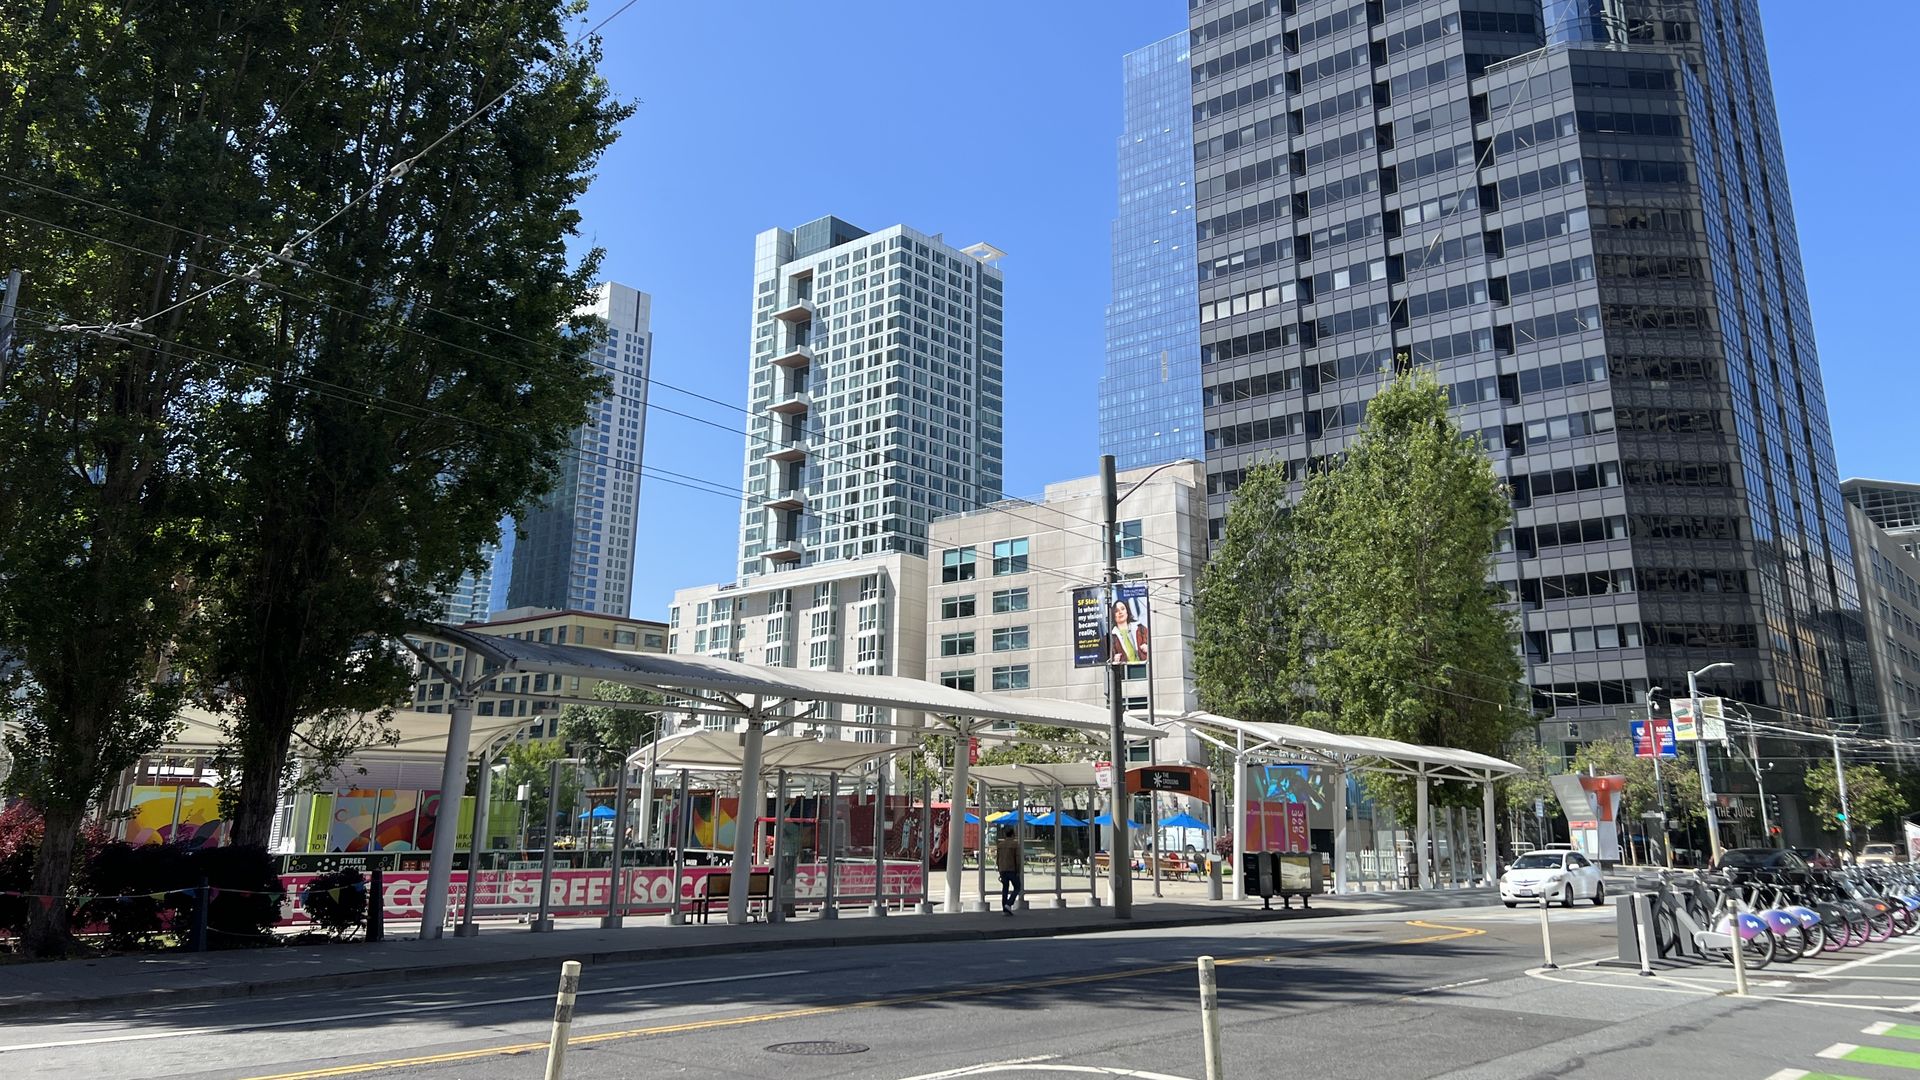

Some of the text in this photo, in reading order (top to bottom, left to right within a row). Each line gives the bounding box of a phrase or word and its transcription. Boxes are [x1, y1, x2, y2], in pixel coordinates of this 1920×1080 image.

[1085, 598, 1100, 606] State
[1078, 606, 1083, 614] is
[1078, 621, 1099, 629] became
[1078, 629, 1097, 637] reality.
[1716, 806, 1755, 818] THE JUICE
[339, 857, 367, 865] STREET
[508, 876, 625, 906] STREET
